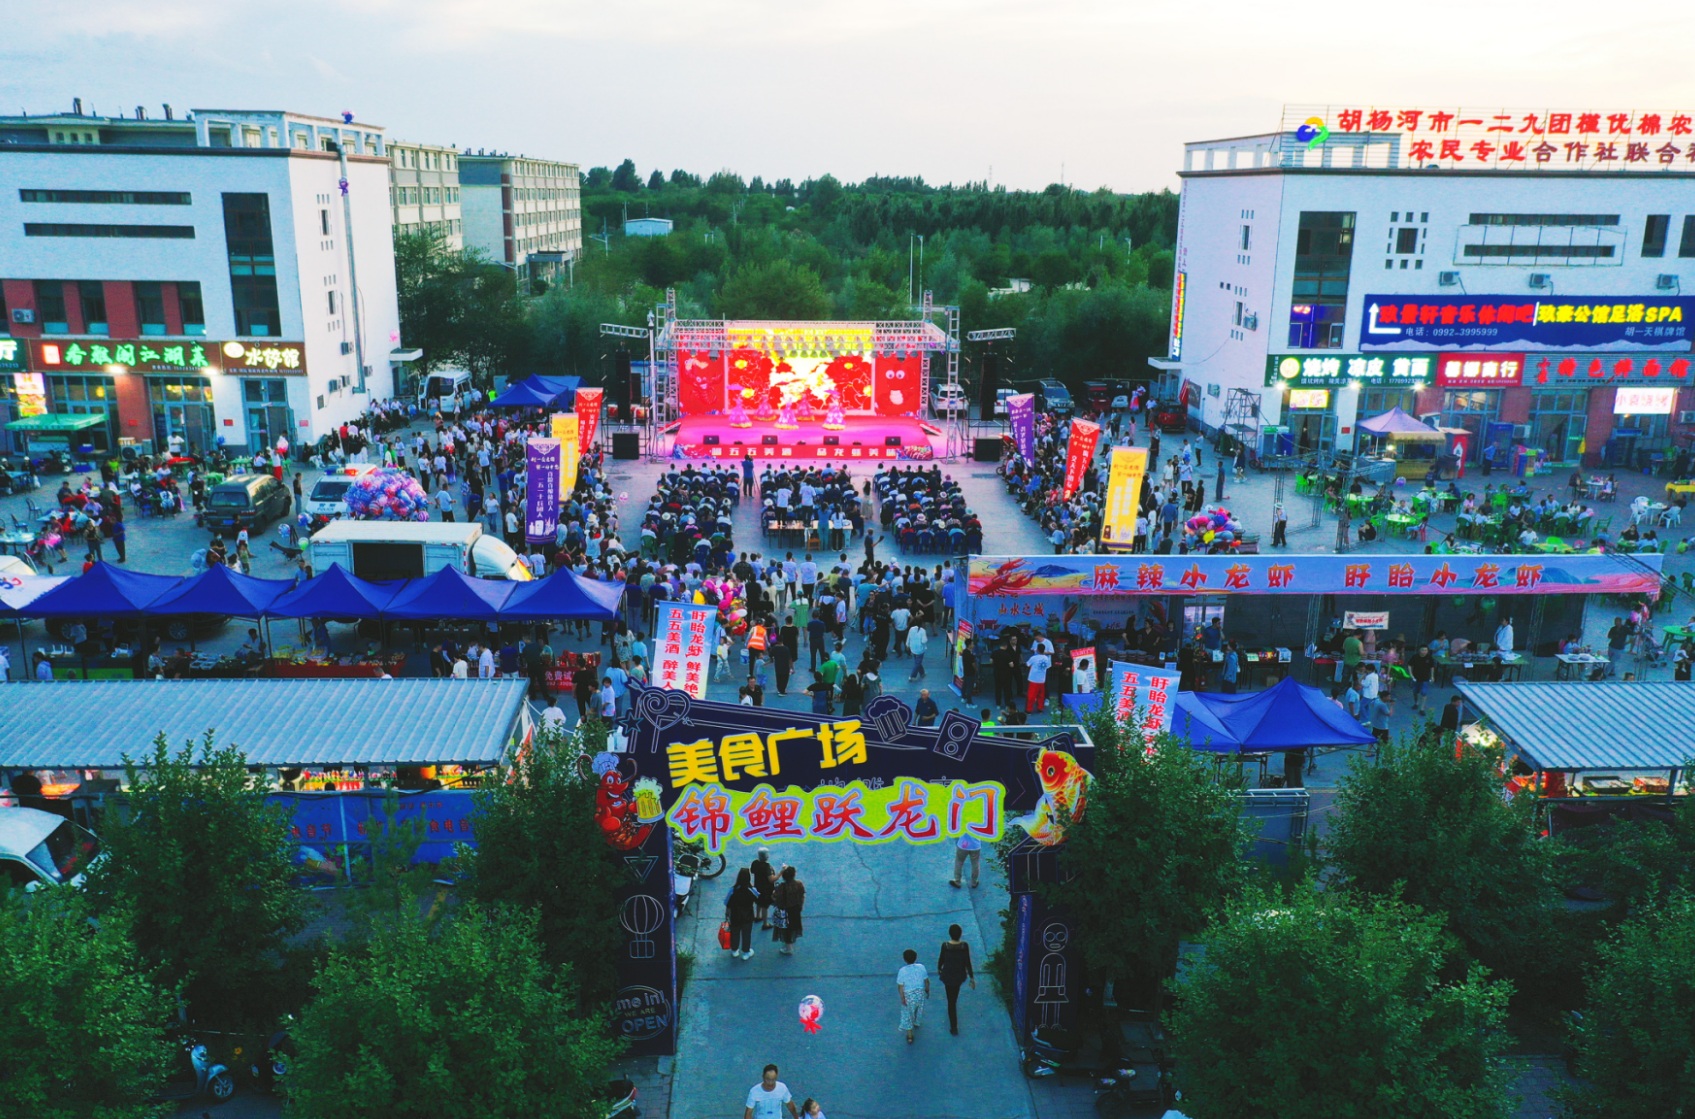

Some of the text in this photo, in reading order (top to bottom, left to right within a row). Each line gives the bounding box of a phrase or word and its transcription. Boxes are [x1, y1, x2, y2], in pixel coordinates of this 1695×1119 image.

[1093, 562, 1295, 590] 麻辣小龙虾
[1344, 562, 1545, 589] 盱眙小龙虾
[665, 608, 684, 654] 五五美酒
[684, 661, 702, 699] 鲜美绝
[666, 720, 867, 787] 美食广场
[672, 782, 1001, 852] 锦鲤跃龙门
[621, 1014, 668, 1034] OPEN
